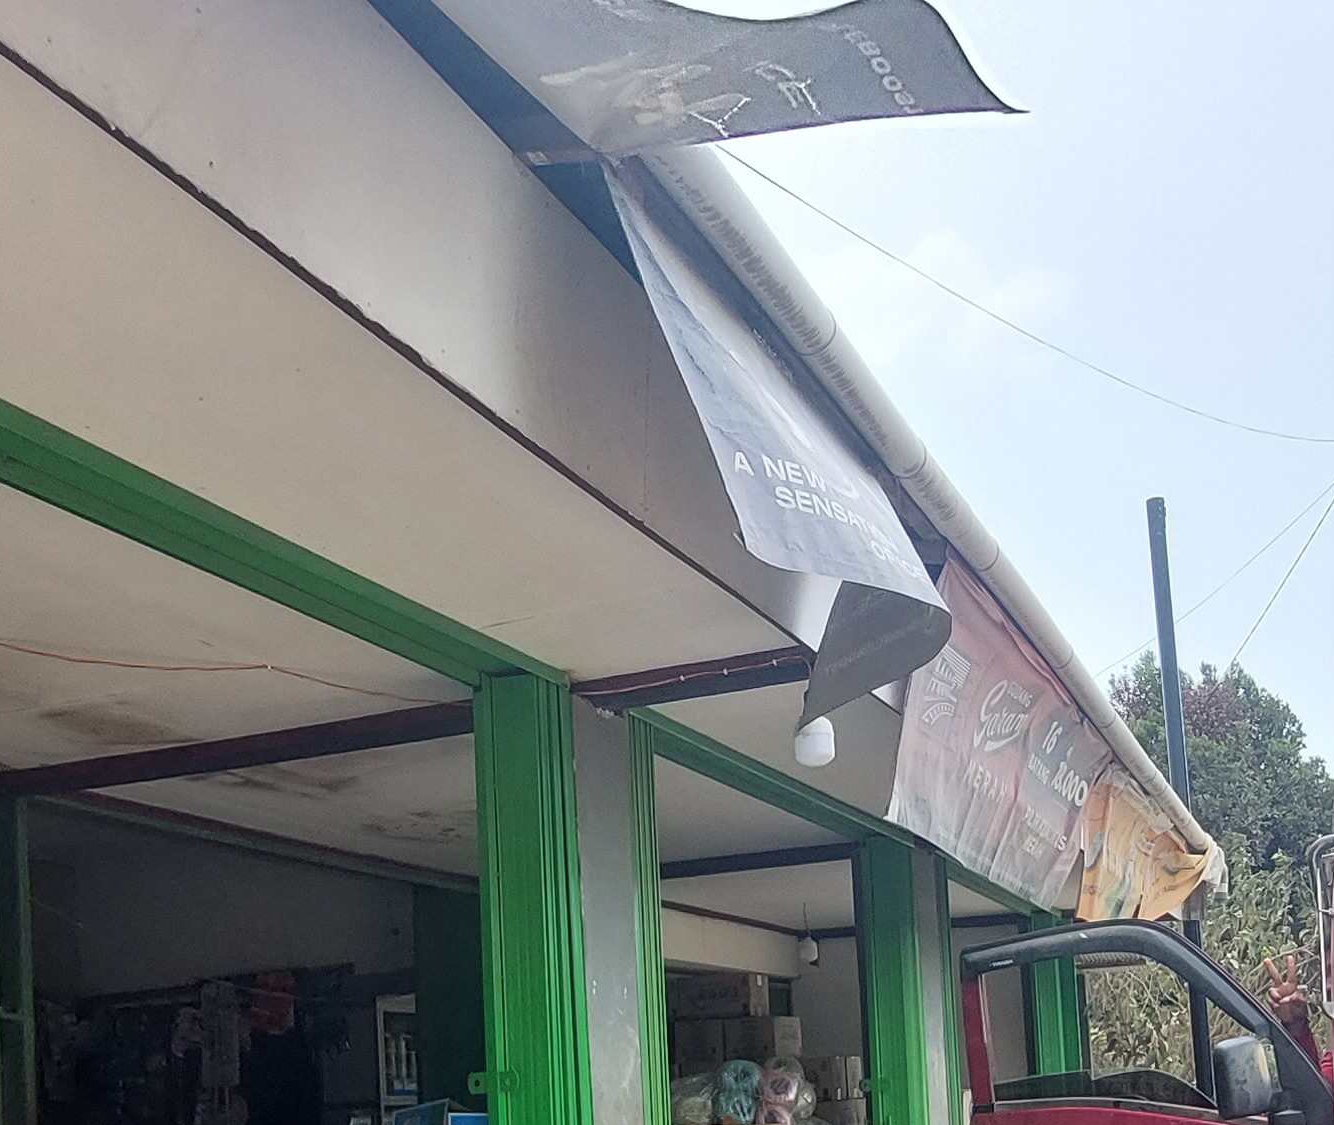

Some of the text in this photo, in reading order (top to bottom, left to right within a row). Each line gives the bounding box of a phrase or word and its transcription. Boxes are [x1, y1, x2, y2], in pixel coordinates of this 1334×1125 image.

[734, 451, 827, 493] A NEW
[775, 485, 899, 555] SENSATION
[1042, 721, 1063, 755] 16
[965, 759, 1008, 802] MERAH
